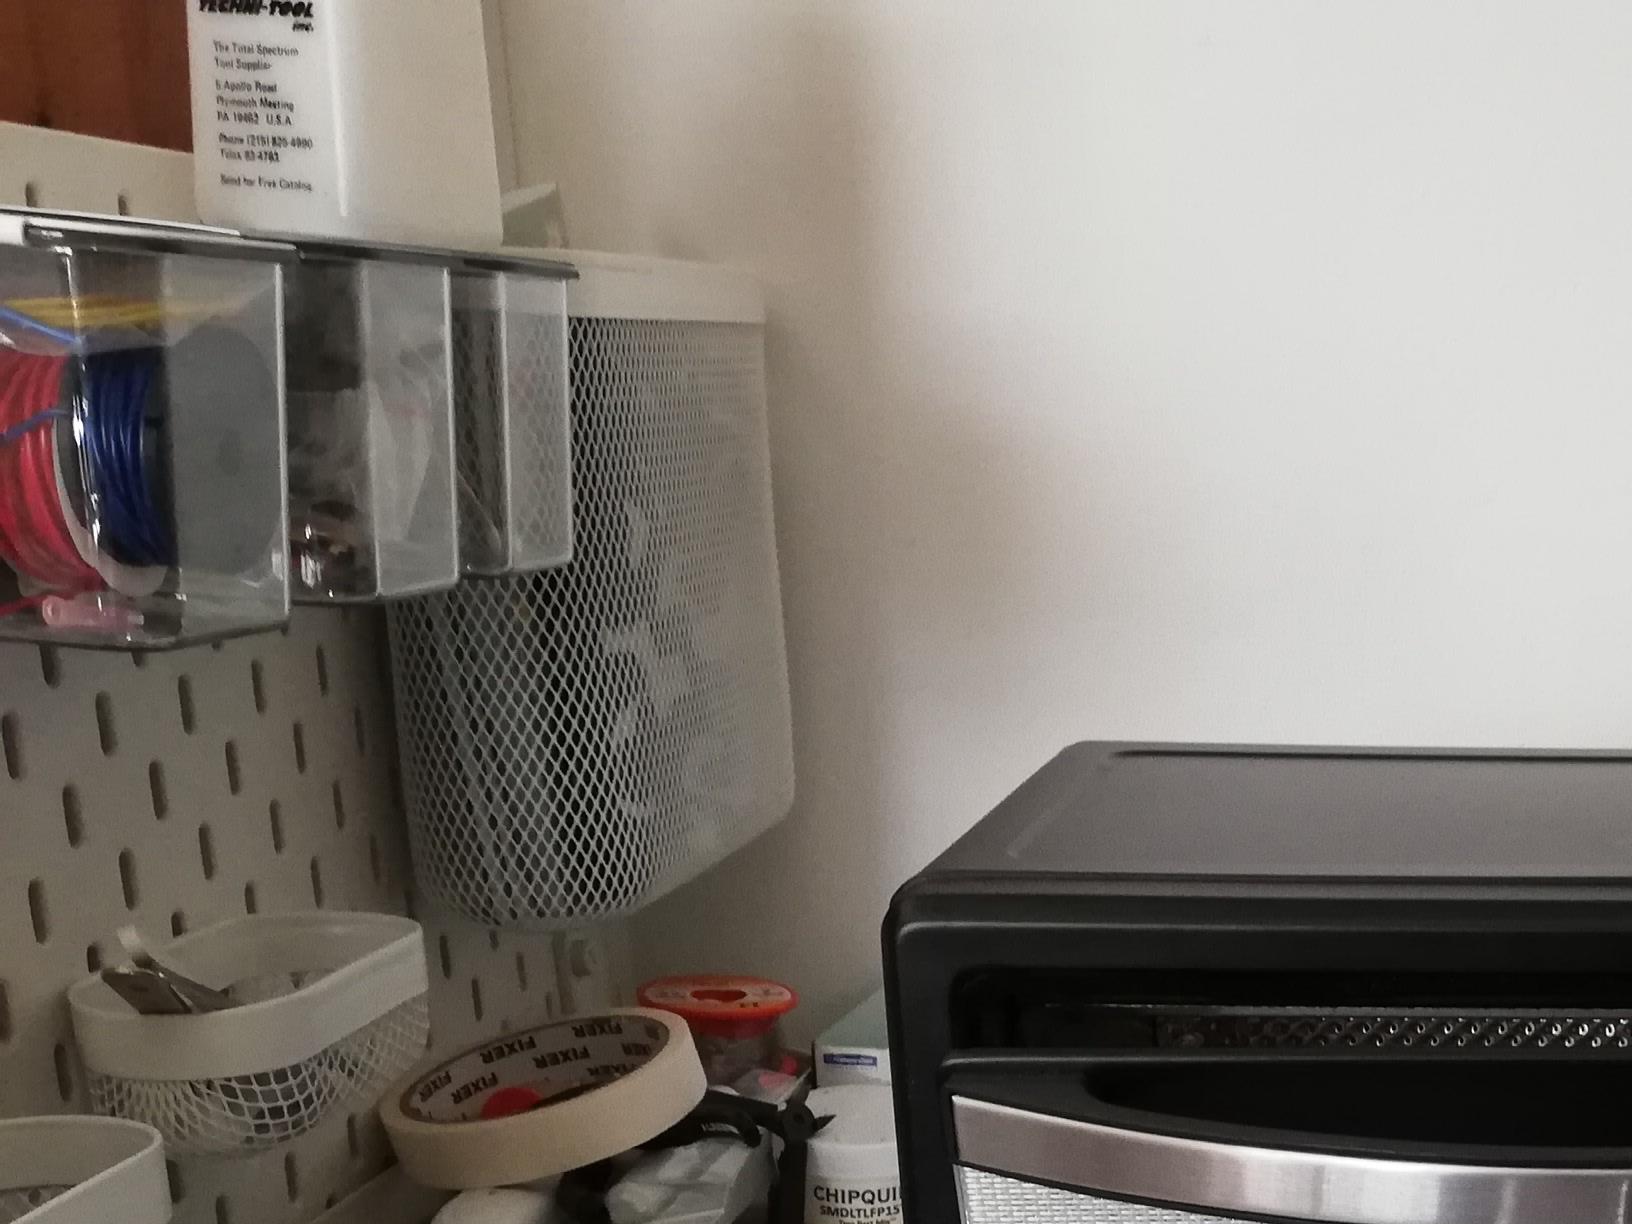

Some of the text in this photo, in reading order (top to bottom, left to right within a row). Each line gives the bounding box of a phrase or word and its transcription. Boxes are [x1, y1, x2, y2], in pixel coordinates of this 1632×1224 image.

[213, 40, 299, 57] The Total Spectrum
[224, 80, 252, 92] Apollo
[260, 96, 294, 113] Meeting
[279, 178, 312, 191] Catalog
[572, 1022, 623, 1038] FIXER
[480, 1036, 537, 1064] FIXER
[532, 1046, 591, 1069] FIXER
[451, 1072, 499, 1105] FIXER
[814, 1185, 898, 1205] CHIPQUI
[819, 1205, 900, 1218] SMDLTLFP15
